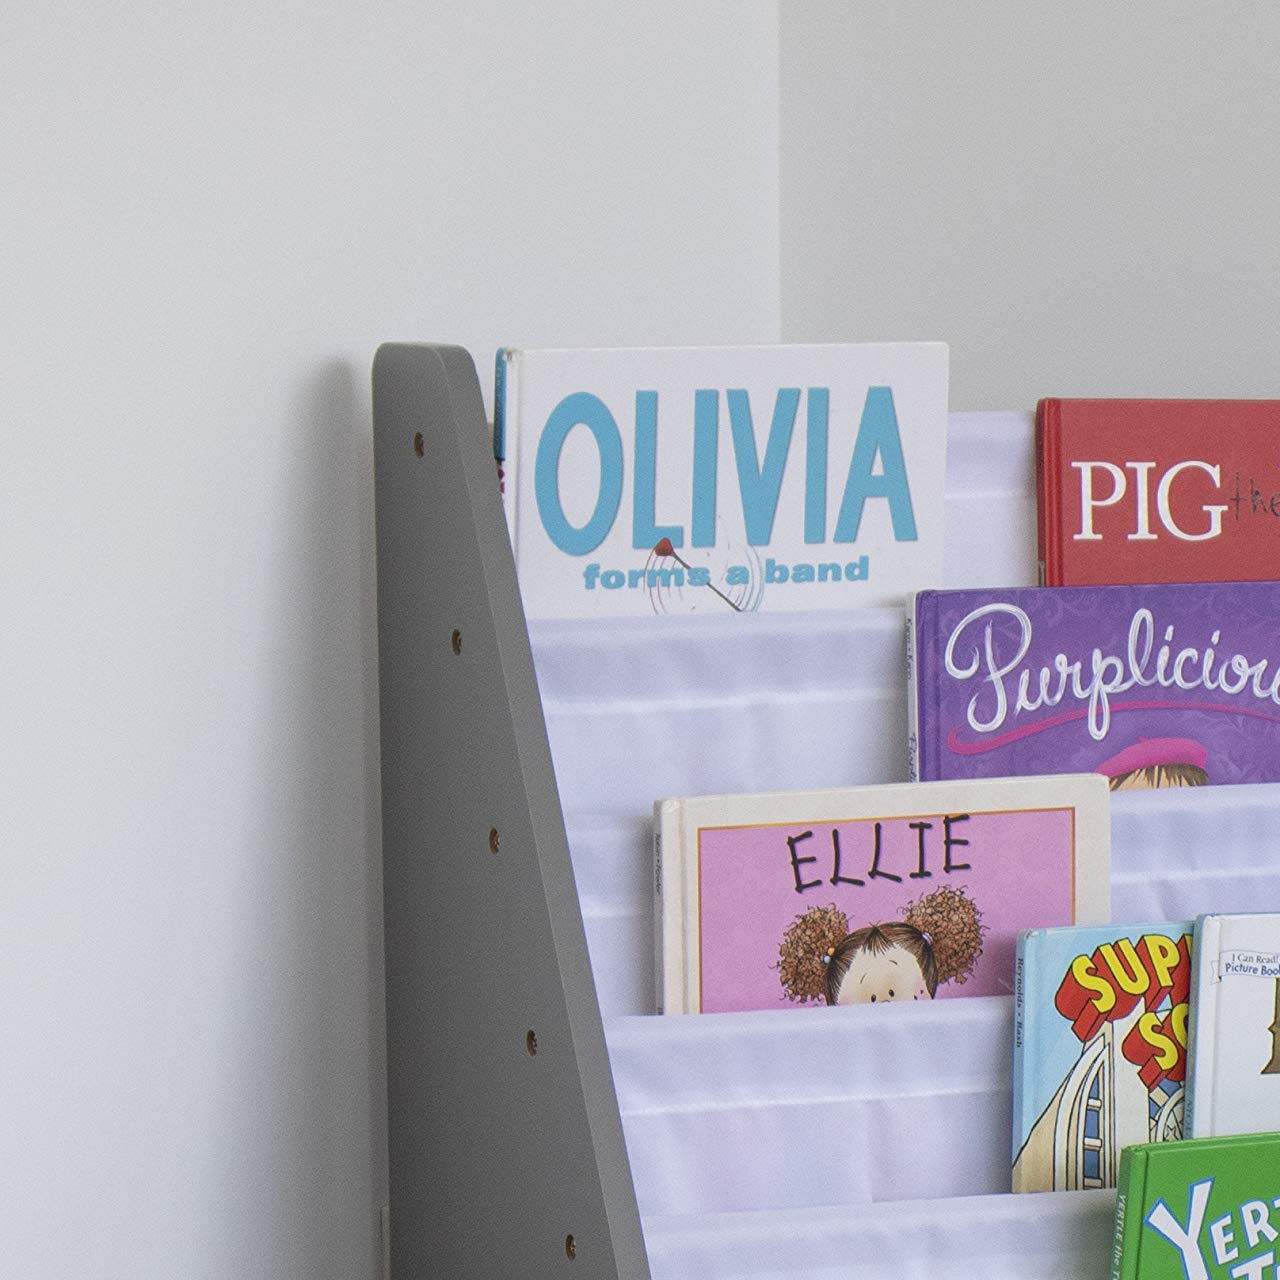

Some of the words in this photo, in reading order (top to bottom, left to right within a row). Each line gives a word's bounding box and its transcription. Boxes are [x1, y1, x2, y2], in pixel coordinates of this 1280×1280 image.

[534, 385, 918, 557] OLIVIA
[1071, 460, 1229, 541] PIG
[582, 562, 712, 590] forms
[725, 564, 751, 586] a
[764, 555, 871, 585] band
[786, 814, 972, 894] ELLIE
[1064, 933, 1193, 1020] SUP
[1225, 962, 1259, 975] Picture
[1238, 953, 1254, 963] Can
[1015, 957, 1024, 1008] Reynolds
[1115, 1194, 1127, 1240] YERTLE
[1113, 1244, 1123, 1266] the
